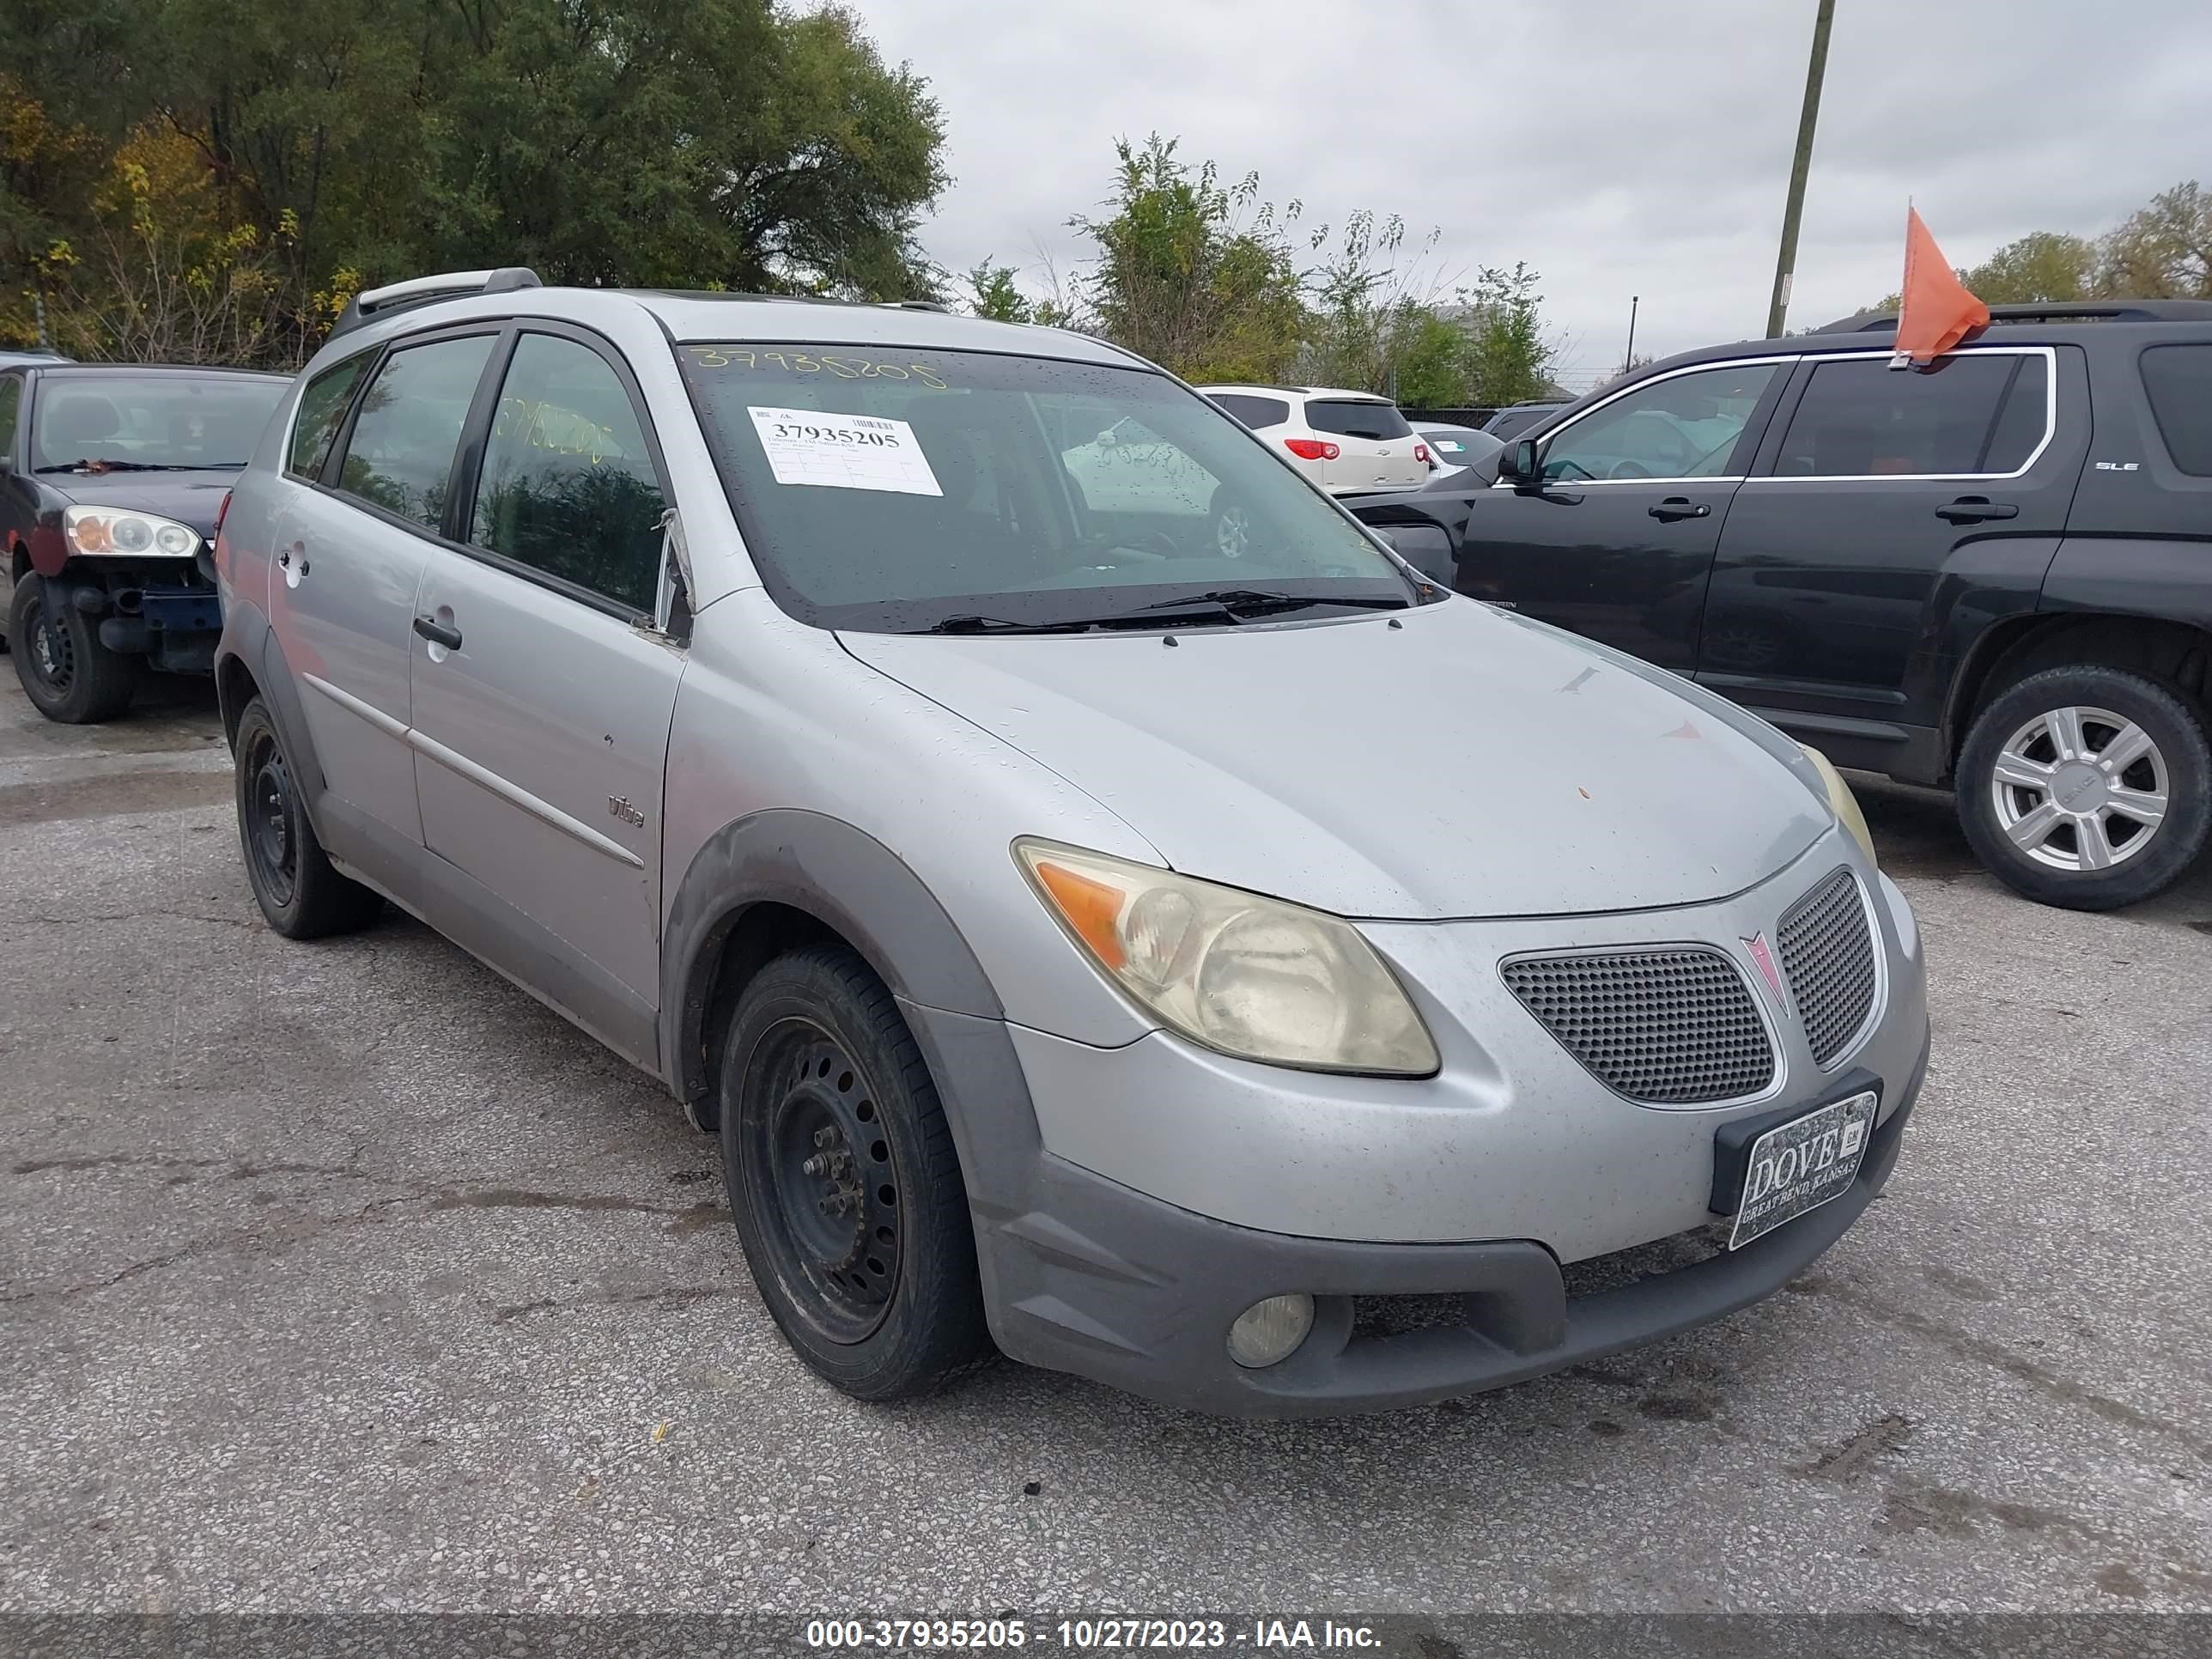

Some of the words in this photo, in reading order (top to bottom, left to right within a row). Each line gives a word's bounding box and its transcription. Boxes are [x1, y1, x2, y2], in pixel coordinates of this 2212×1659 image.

[689, 349, 947, 389] 37935205
[772, 424, 900, 448] 37935205
[2095, 462, 2139, 471] SLE
[1846, 1128, 1860, 1145] GM
[1749, 1128, 1839, 1203] DOVE
[1742, 1197, 1779, 1224] GREAT
[1811, 1160, 1856, 1191] KANSAS
